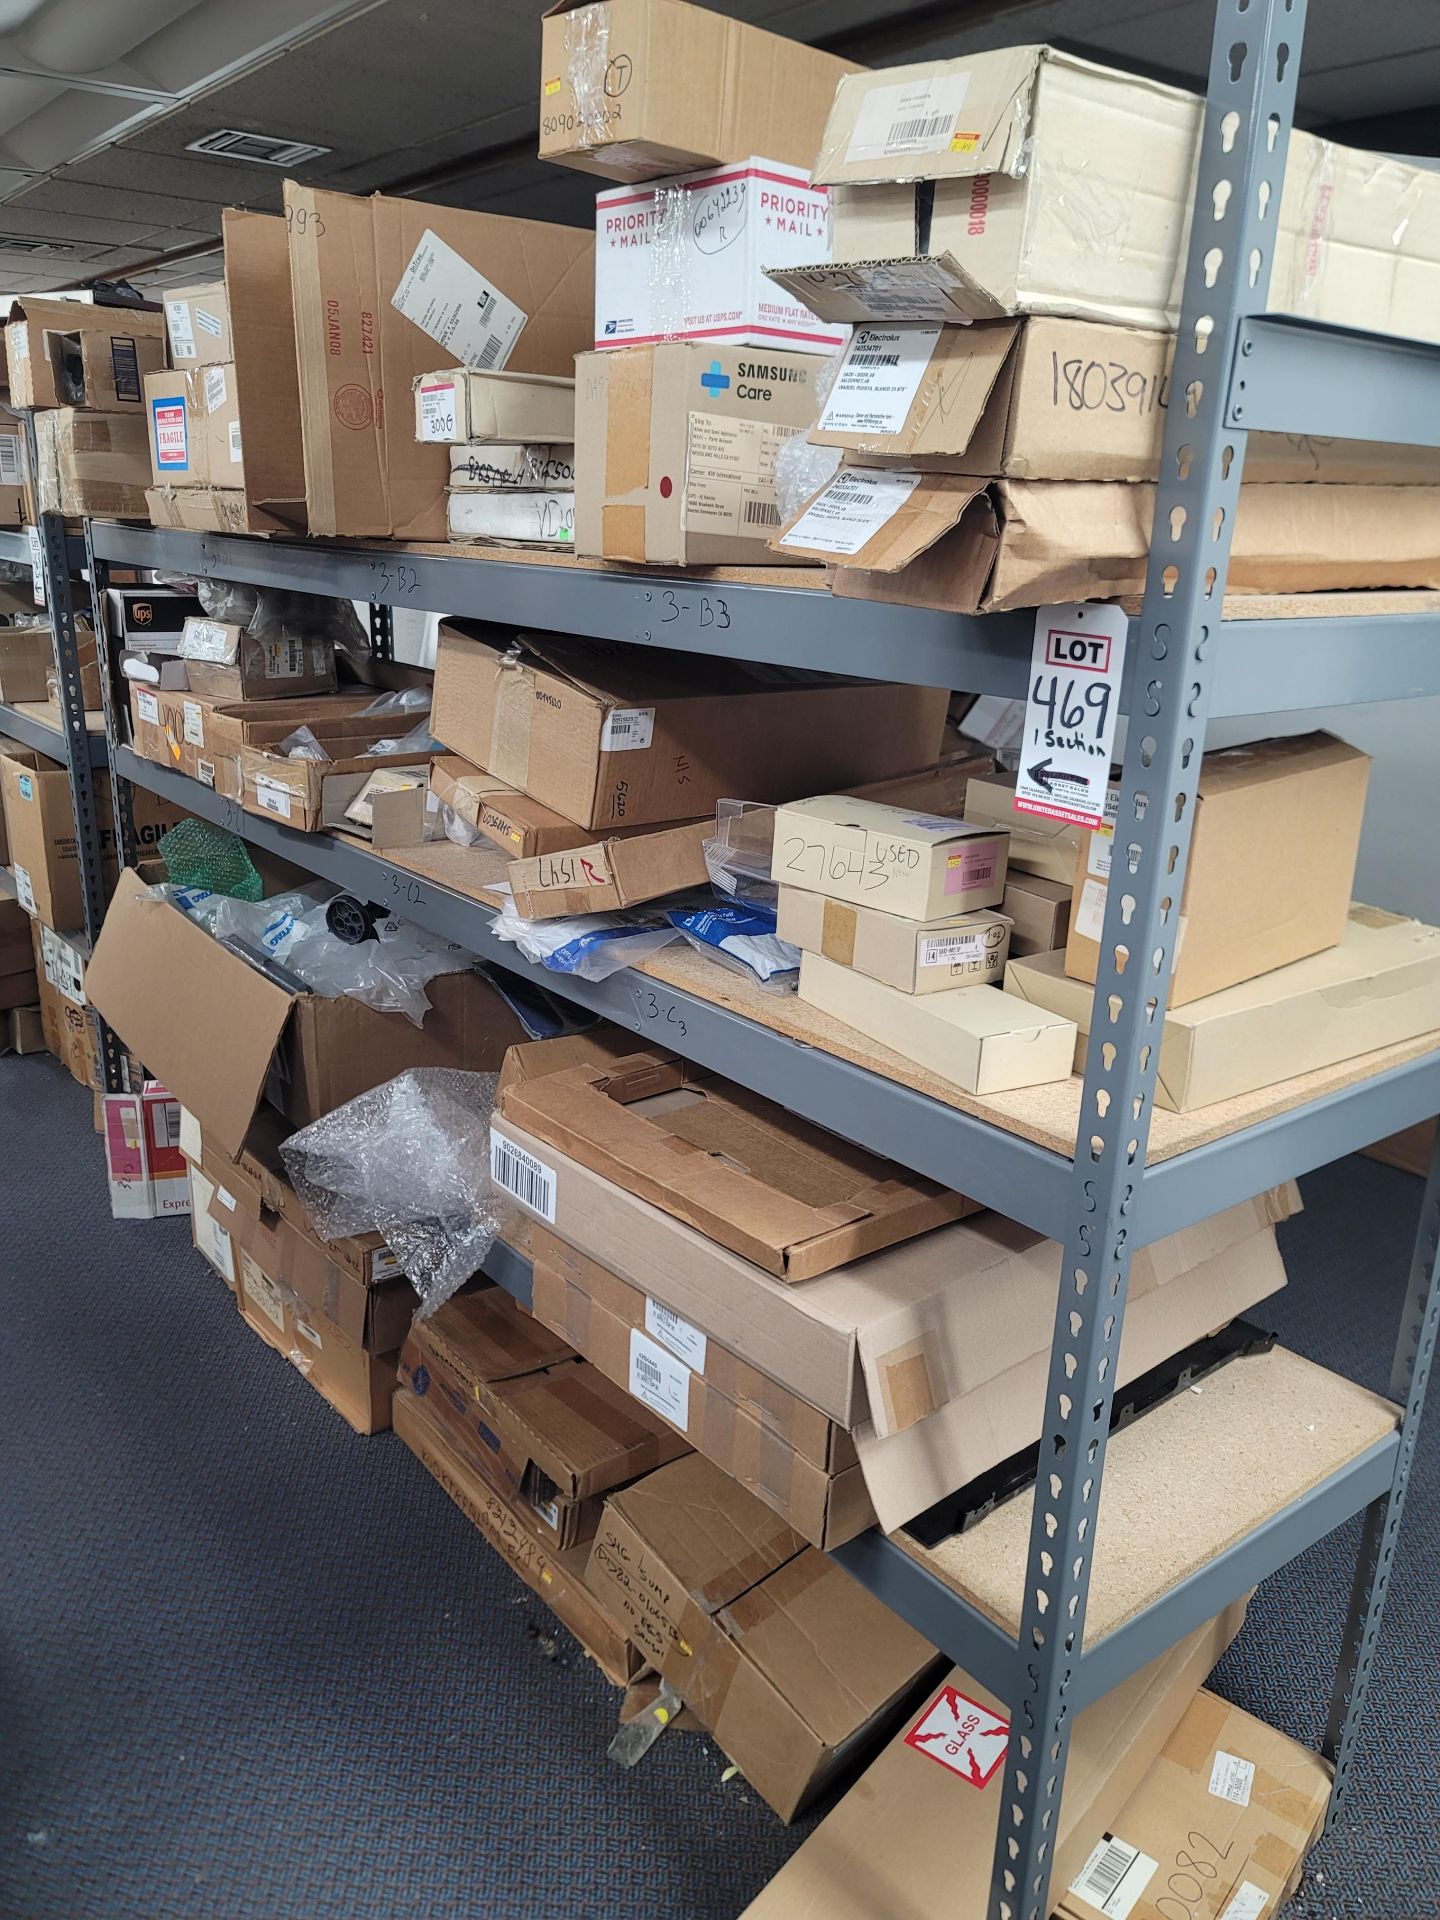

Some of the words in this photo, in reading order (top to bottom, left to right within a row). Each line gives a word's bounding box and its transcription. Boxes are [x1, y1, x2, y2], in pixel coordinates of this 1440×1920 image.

[760, 192, 829, 222] PRIORITY
[606, 207, 668, 235] PRIORITY
[777, 216, 812, 237] MAIL
[620, 234, 651, 249] MAIL
[758, 302, 783, 315] MEDIUM
[784, 306, 799, 317] FLAT
[869, 334, 900, 342] Electrolux
[736, 385, 772, 401] Care
[159, 431, 184, 444] FRAGILE
[849, 476, 878, 485] Electrolux
[134, 609, 151, 622] ups
[661, 590, 731, 629] 3-B3
[1054, 637, 1104, 664] LOT
[1032, 675, 1112, 739] 469
[784, 837, 889, 890] 27643
[876, 841, 920, 869] USED
[928, 952, 935, 960] 14
[944, 1713, 980, 1757] GLASS
